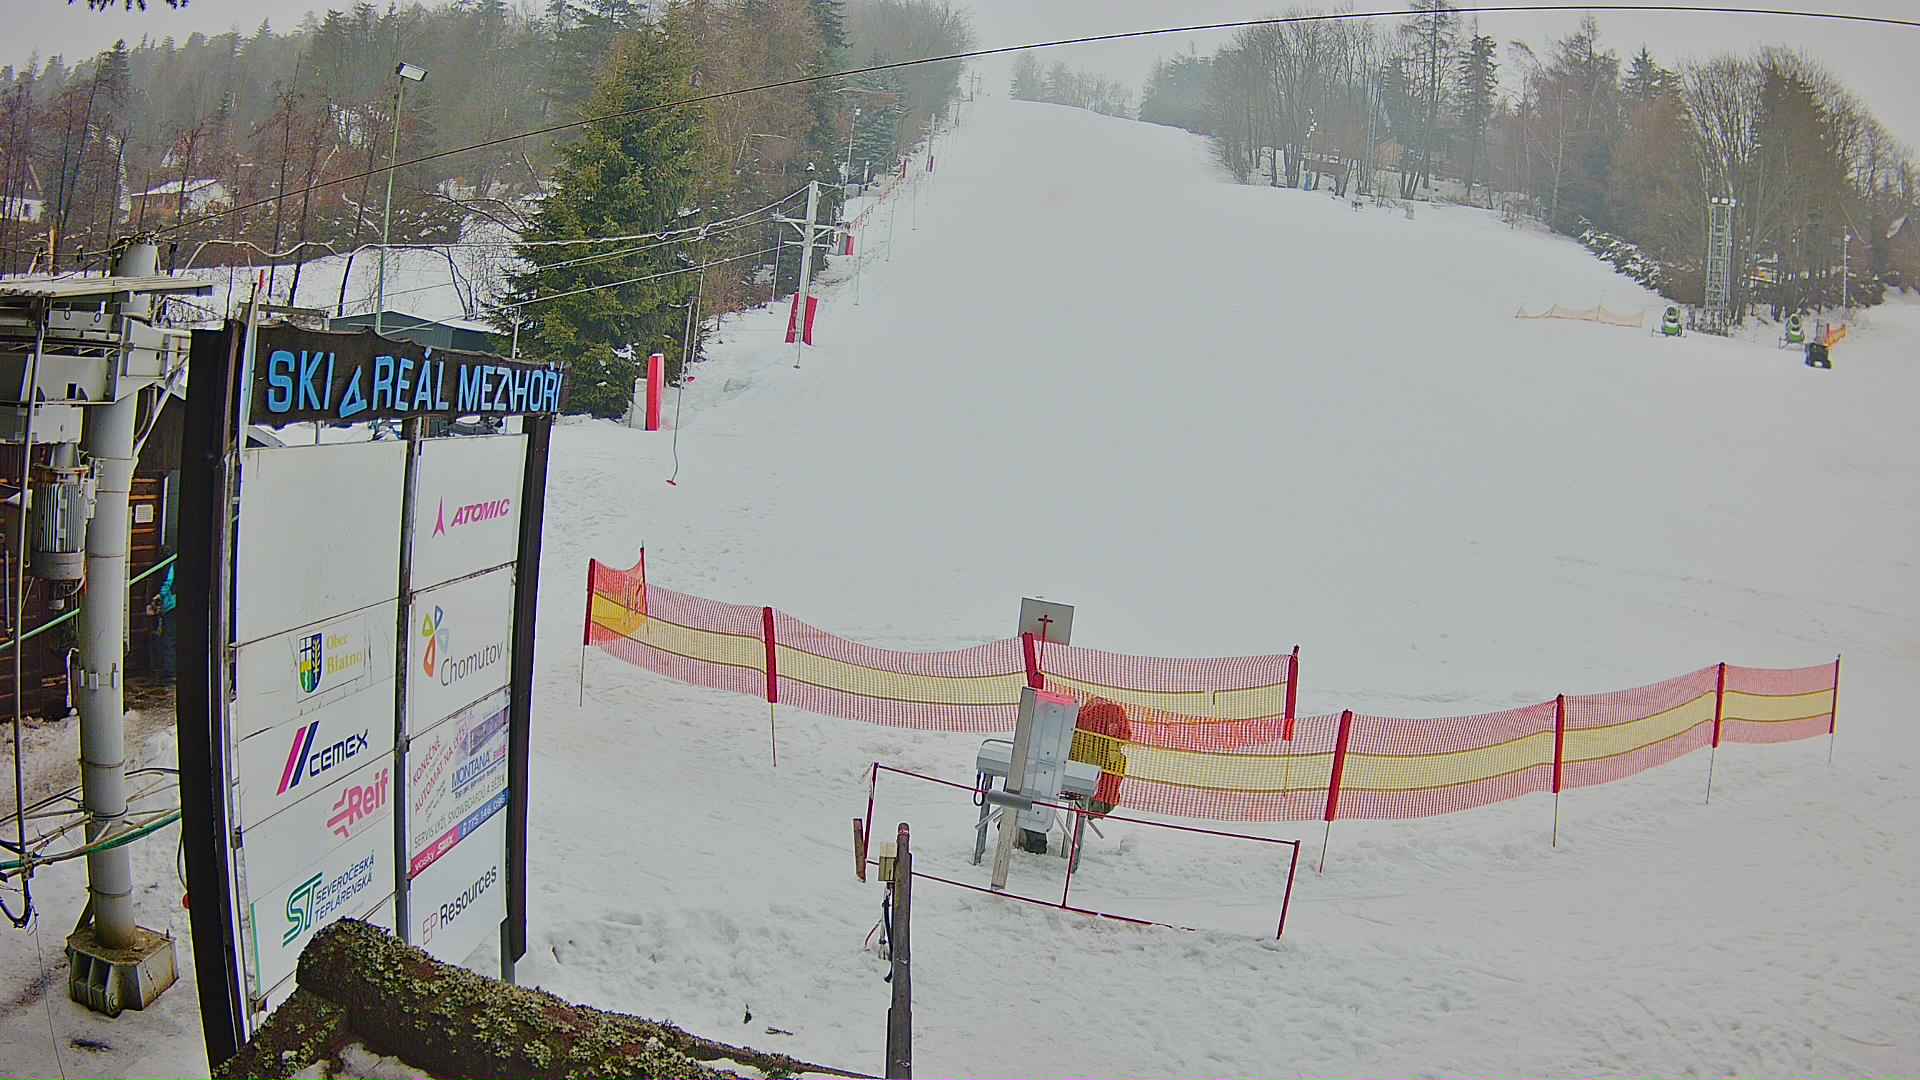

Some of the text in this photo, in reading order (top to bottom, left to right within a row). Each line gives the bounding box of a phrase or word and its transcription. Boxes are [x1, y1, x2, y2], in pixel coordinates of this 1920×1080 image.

[267, 350, 335, 413] SKI
[451, 499, 510, 527] ATOMIC
[441, 640, 503, 687] Chomutov
[309, 728, 368, 777] CEMEX
[452, 751, 490, 789] MONTANA
[348, 768, 388, 825] Reif
[315, 849, 374, 906] SEVEROČESKÁ
[423, 866, 496, 945] EP Resources
